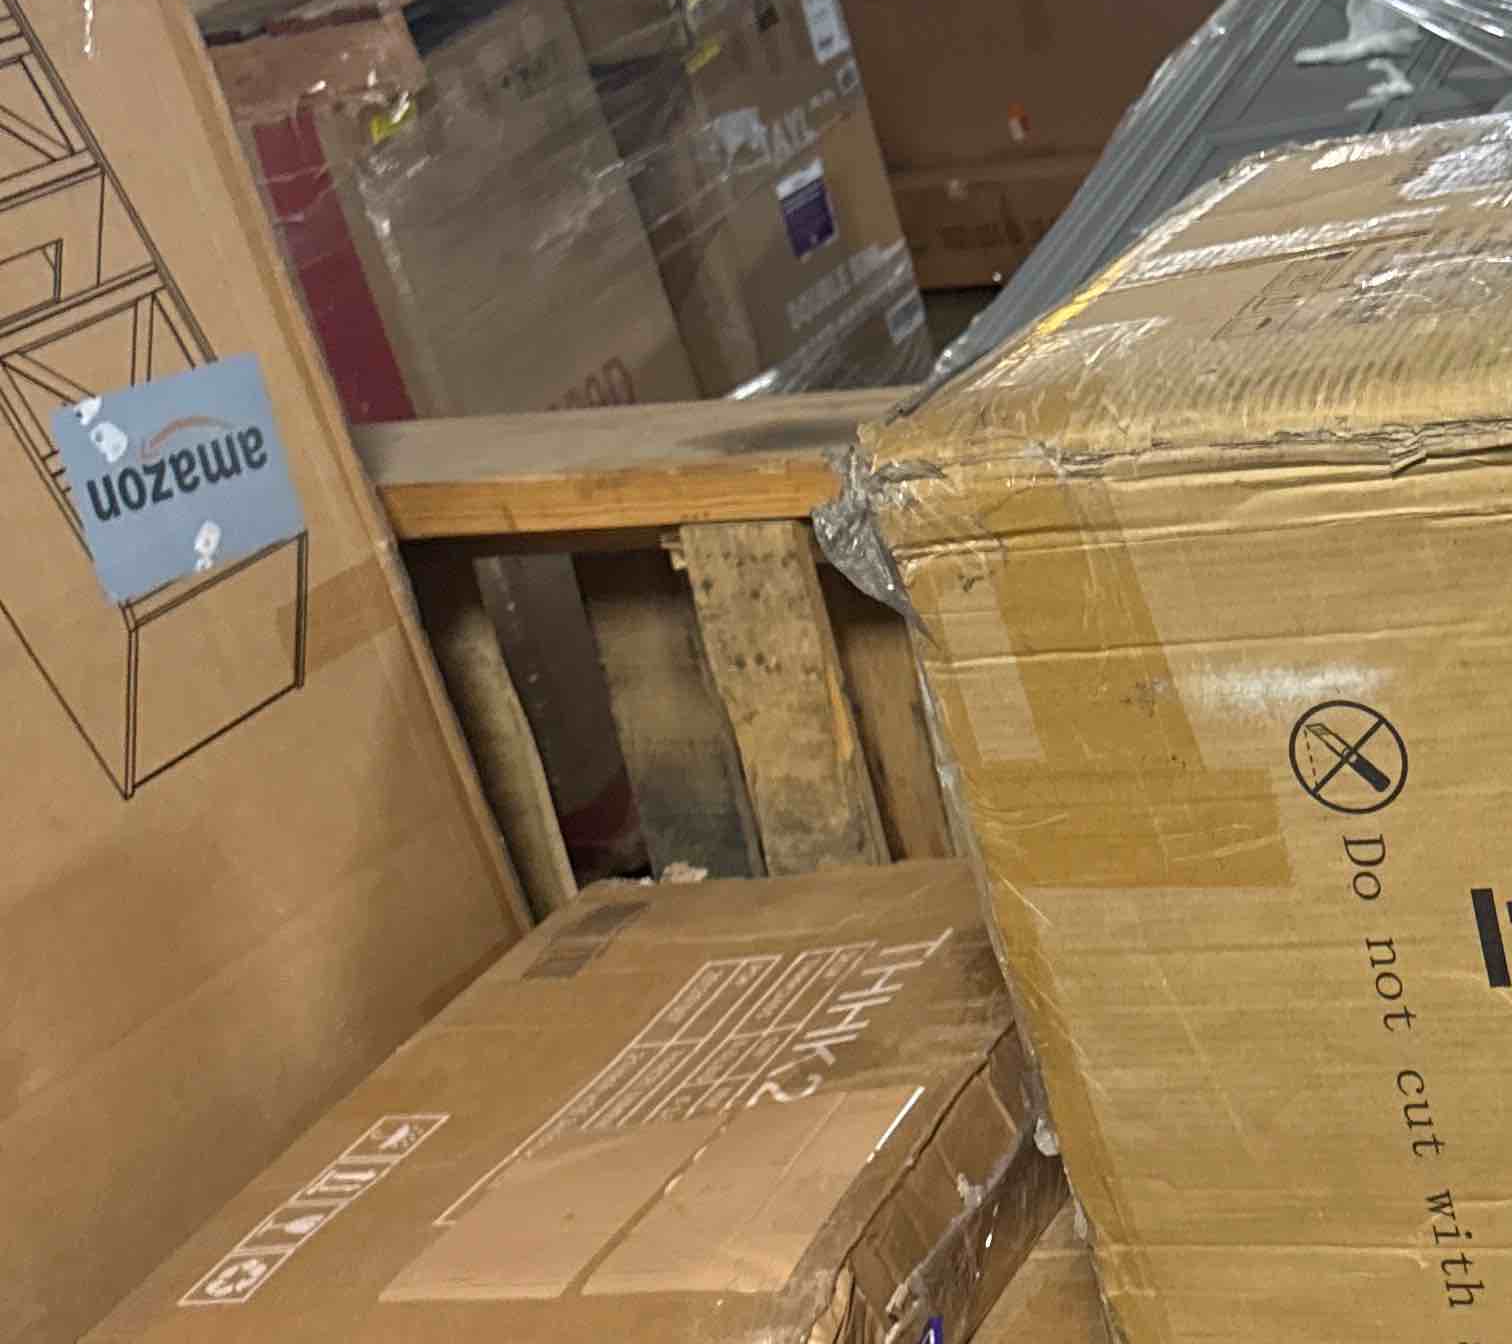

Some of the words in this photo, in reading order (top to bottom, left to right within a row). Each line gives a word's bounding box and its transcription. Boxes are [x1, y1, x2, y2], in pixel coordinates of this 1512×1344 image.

[85, 425, 268, 522] amazon
[746, 927, 954, 1107] THHK2
[1342, 833, 1387, 902] Do
[1365, 935, 1417, 1033] not
[1396, 1068, 1445, 1159] cut
[1425, 1189, 1486, 1309] with
